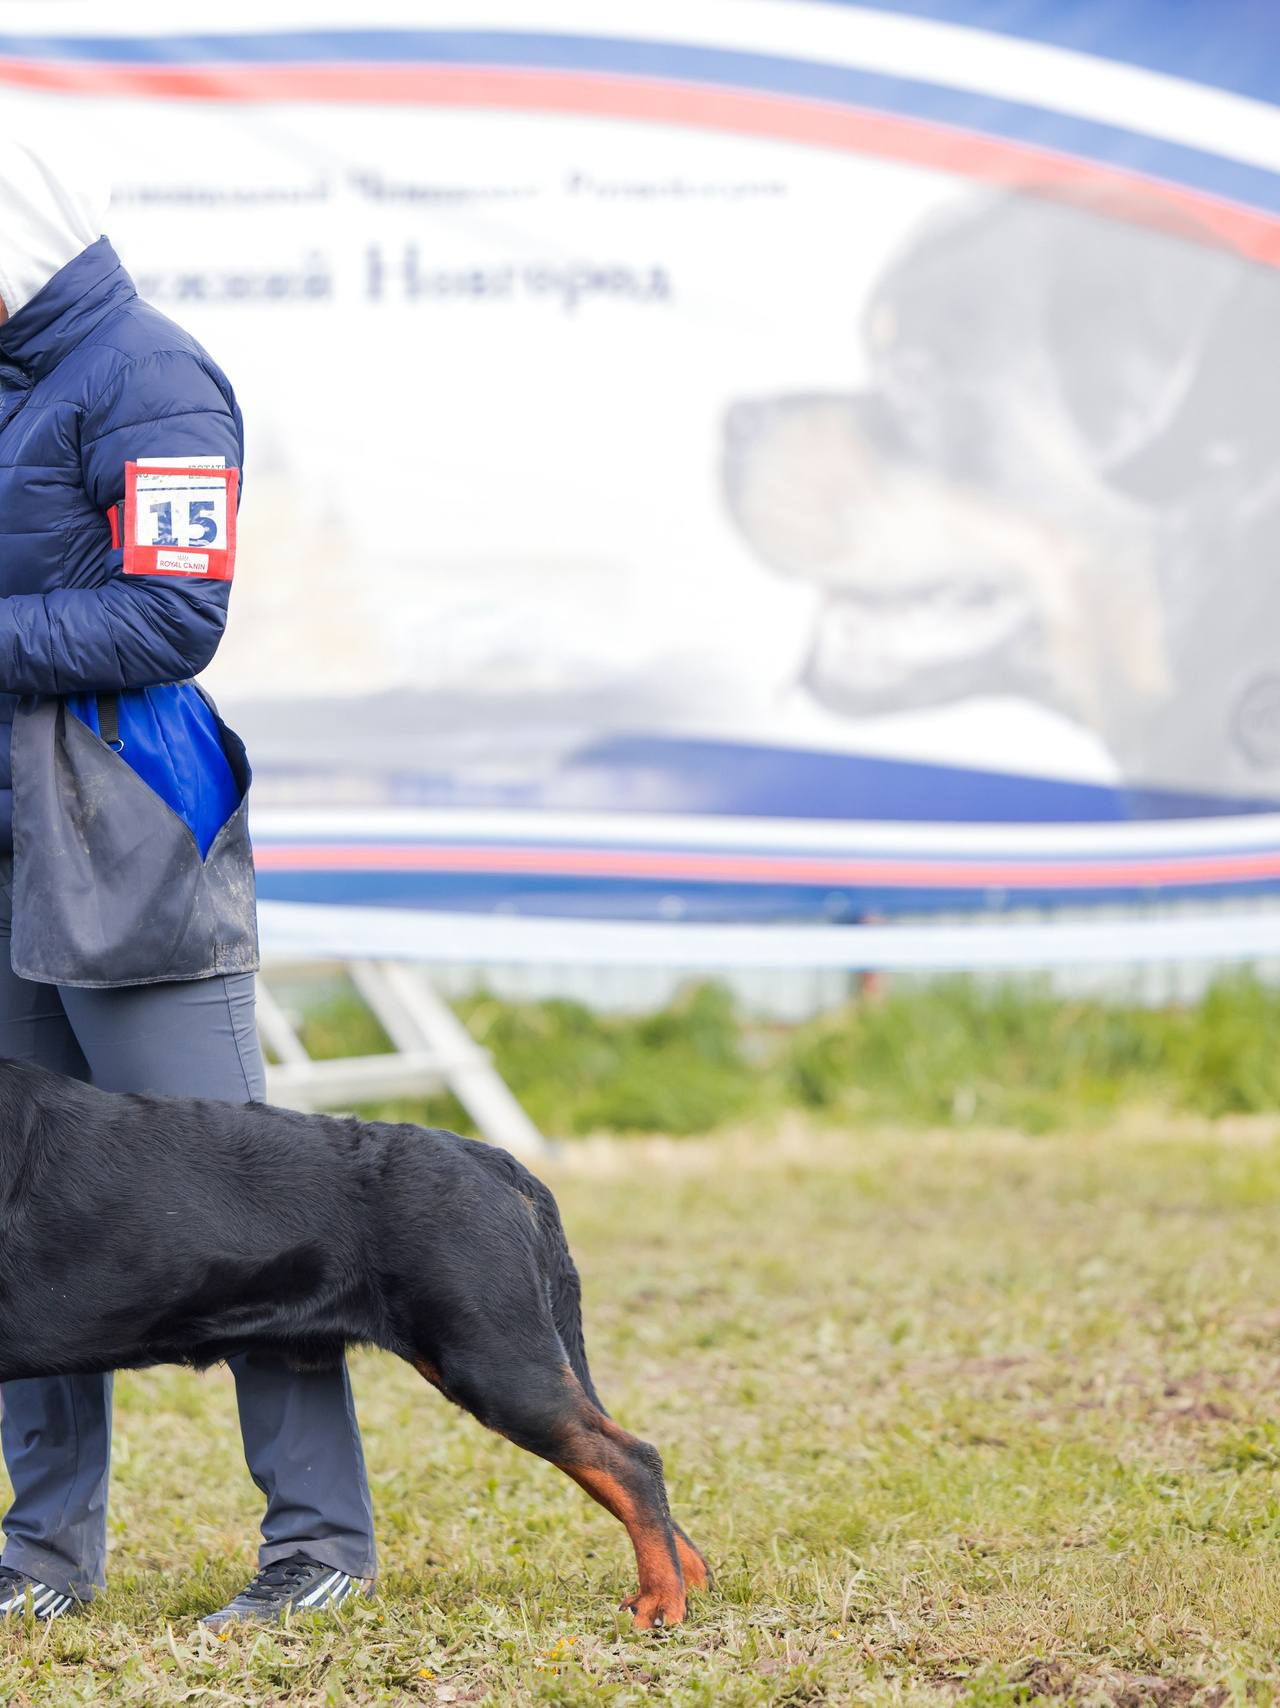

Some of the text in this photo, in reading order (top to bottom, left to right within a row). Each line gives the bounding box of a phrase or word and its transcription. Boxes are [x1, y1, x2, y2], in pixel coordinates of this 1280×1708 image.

[150, 500, 217, 547] 15
[159, 560, 206, 570] ROYAL CANIN
